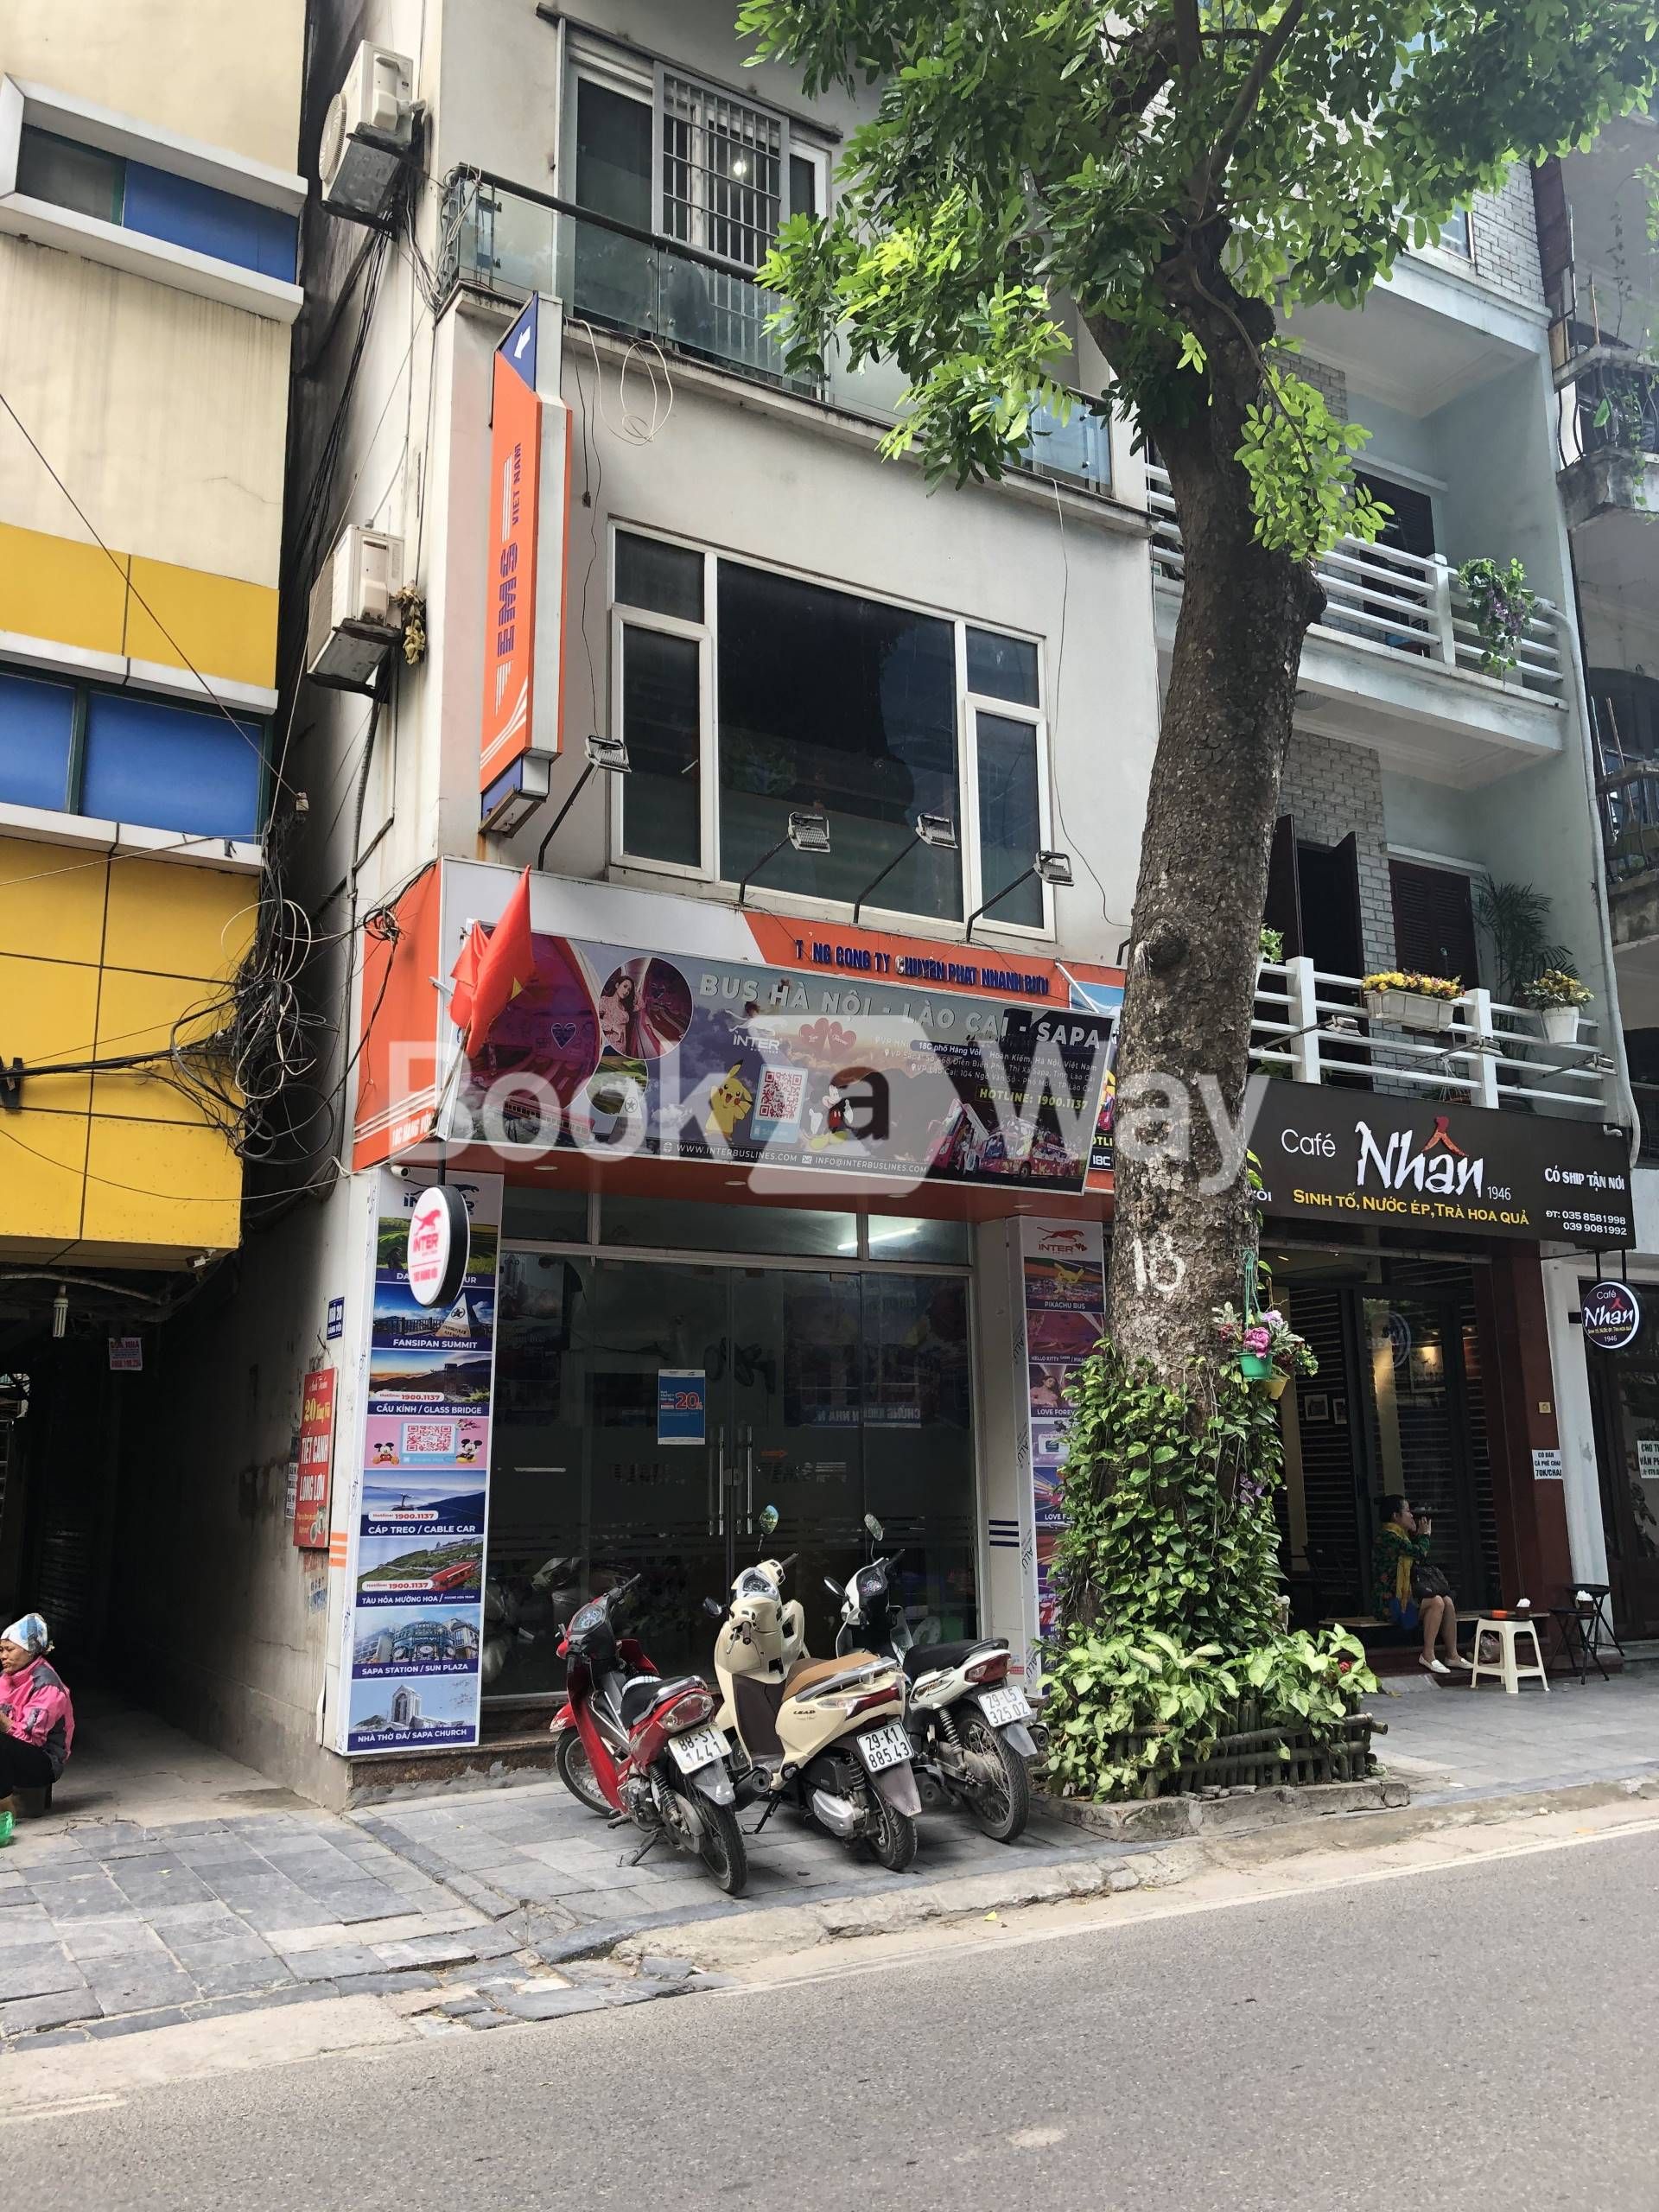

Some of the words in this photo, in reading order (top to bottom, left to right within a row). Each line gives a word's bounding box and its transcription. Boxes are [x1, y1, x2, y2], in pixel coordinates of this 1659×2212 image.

[497, 542, 518, 658] EMS
[874, 952, 891, 973] TY
[980, 968, 1022, 993] NHANH
[699, 974, 760, 1002] BUS
[769, 982, 810, 1010] HÀ
[821, 989, 872, 1022] NỘI
[901, 1000, 956, 1029] LÀO
[965, 1012, 1010, 1039] CAI
[1037, 1021, 1101, 1050] SAPA
[918, 1041, 932, 1051] 18C
[933, 1044, 948, 1053] phố
[949, 1045, 968, 1055] Hàng
[1080, 1062, 1097, 1071] Nam
[980, 1088, 1033, 1103] HOTLINE:
[1037, 1095, 1089, 1109] 1900.1137
[677, 1144, 798, 1163] WWW.INTERBUSLINES.COM
[815, 1156, 928, 1173] INFO@INTERBUSLINES.COM
[1092, 1154, 1111, 1166] 18C
[1281, 1128, 1336, 1158] Café
[1355, 1116, 1484, 1198] Nhân
[1487, 1185, 1511, 1201] 1946
[1544, 1166, 1560, 1183] CÓ
[1562, 1171, 1585, 1185] SHIP
[1586, 1171, 1606, 1192] TẬN
[1546, 1210, 1560, 1219] ĐT:
[1562, 1211, 1582, 1221] 035
[1583, 1211, 1626, 1224] 8581998
[1562, 1222, 1582, 1231] 039
[1584, 1223, 1627, 1236] 9081992
[414, 1233, 438, 1252] INTER
[1038, 1243, 1073, 1253] INTER
[1597, 1289, 1617, 1299] Café
[1045, 1300, 1072, 1309] PIKACHU
[393, 1339, 440, 1348] FANSIPAN
[442, 1340, 478, 1349] SUMMIT
[396, 1404, 416, 1414] KÍNH
[368, 1525, 388, 1534] CÁP
[390, 1526, 416, 1535] TREO
[424, 1525, 454, 1534] CABLE
[362, 1596, 376, 1605] TÀU
[395, 1595, 422, 1604] MƯỜNG
[443, 1663, 468, 1672] PLAZA
[986, 1688, 1018, 1709] 29-L5
[358, 1732, 376, 1743] NHÀ
[377, 1732, 394, 1741] THỜ
[412, 1730, 433, 1739] SAPA
[434, 1729, 467, 1738] CHURCH
[865, 1726, 899, 1751] 29-K1
[868, 1741, 911, 1770] 885.43
